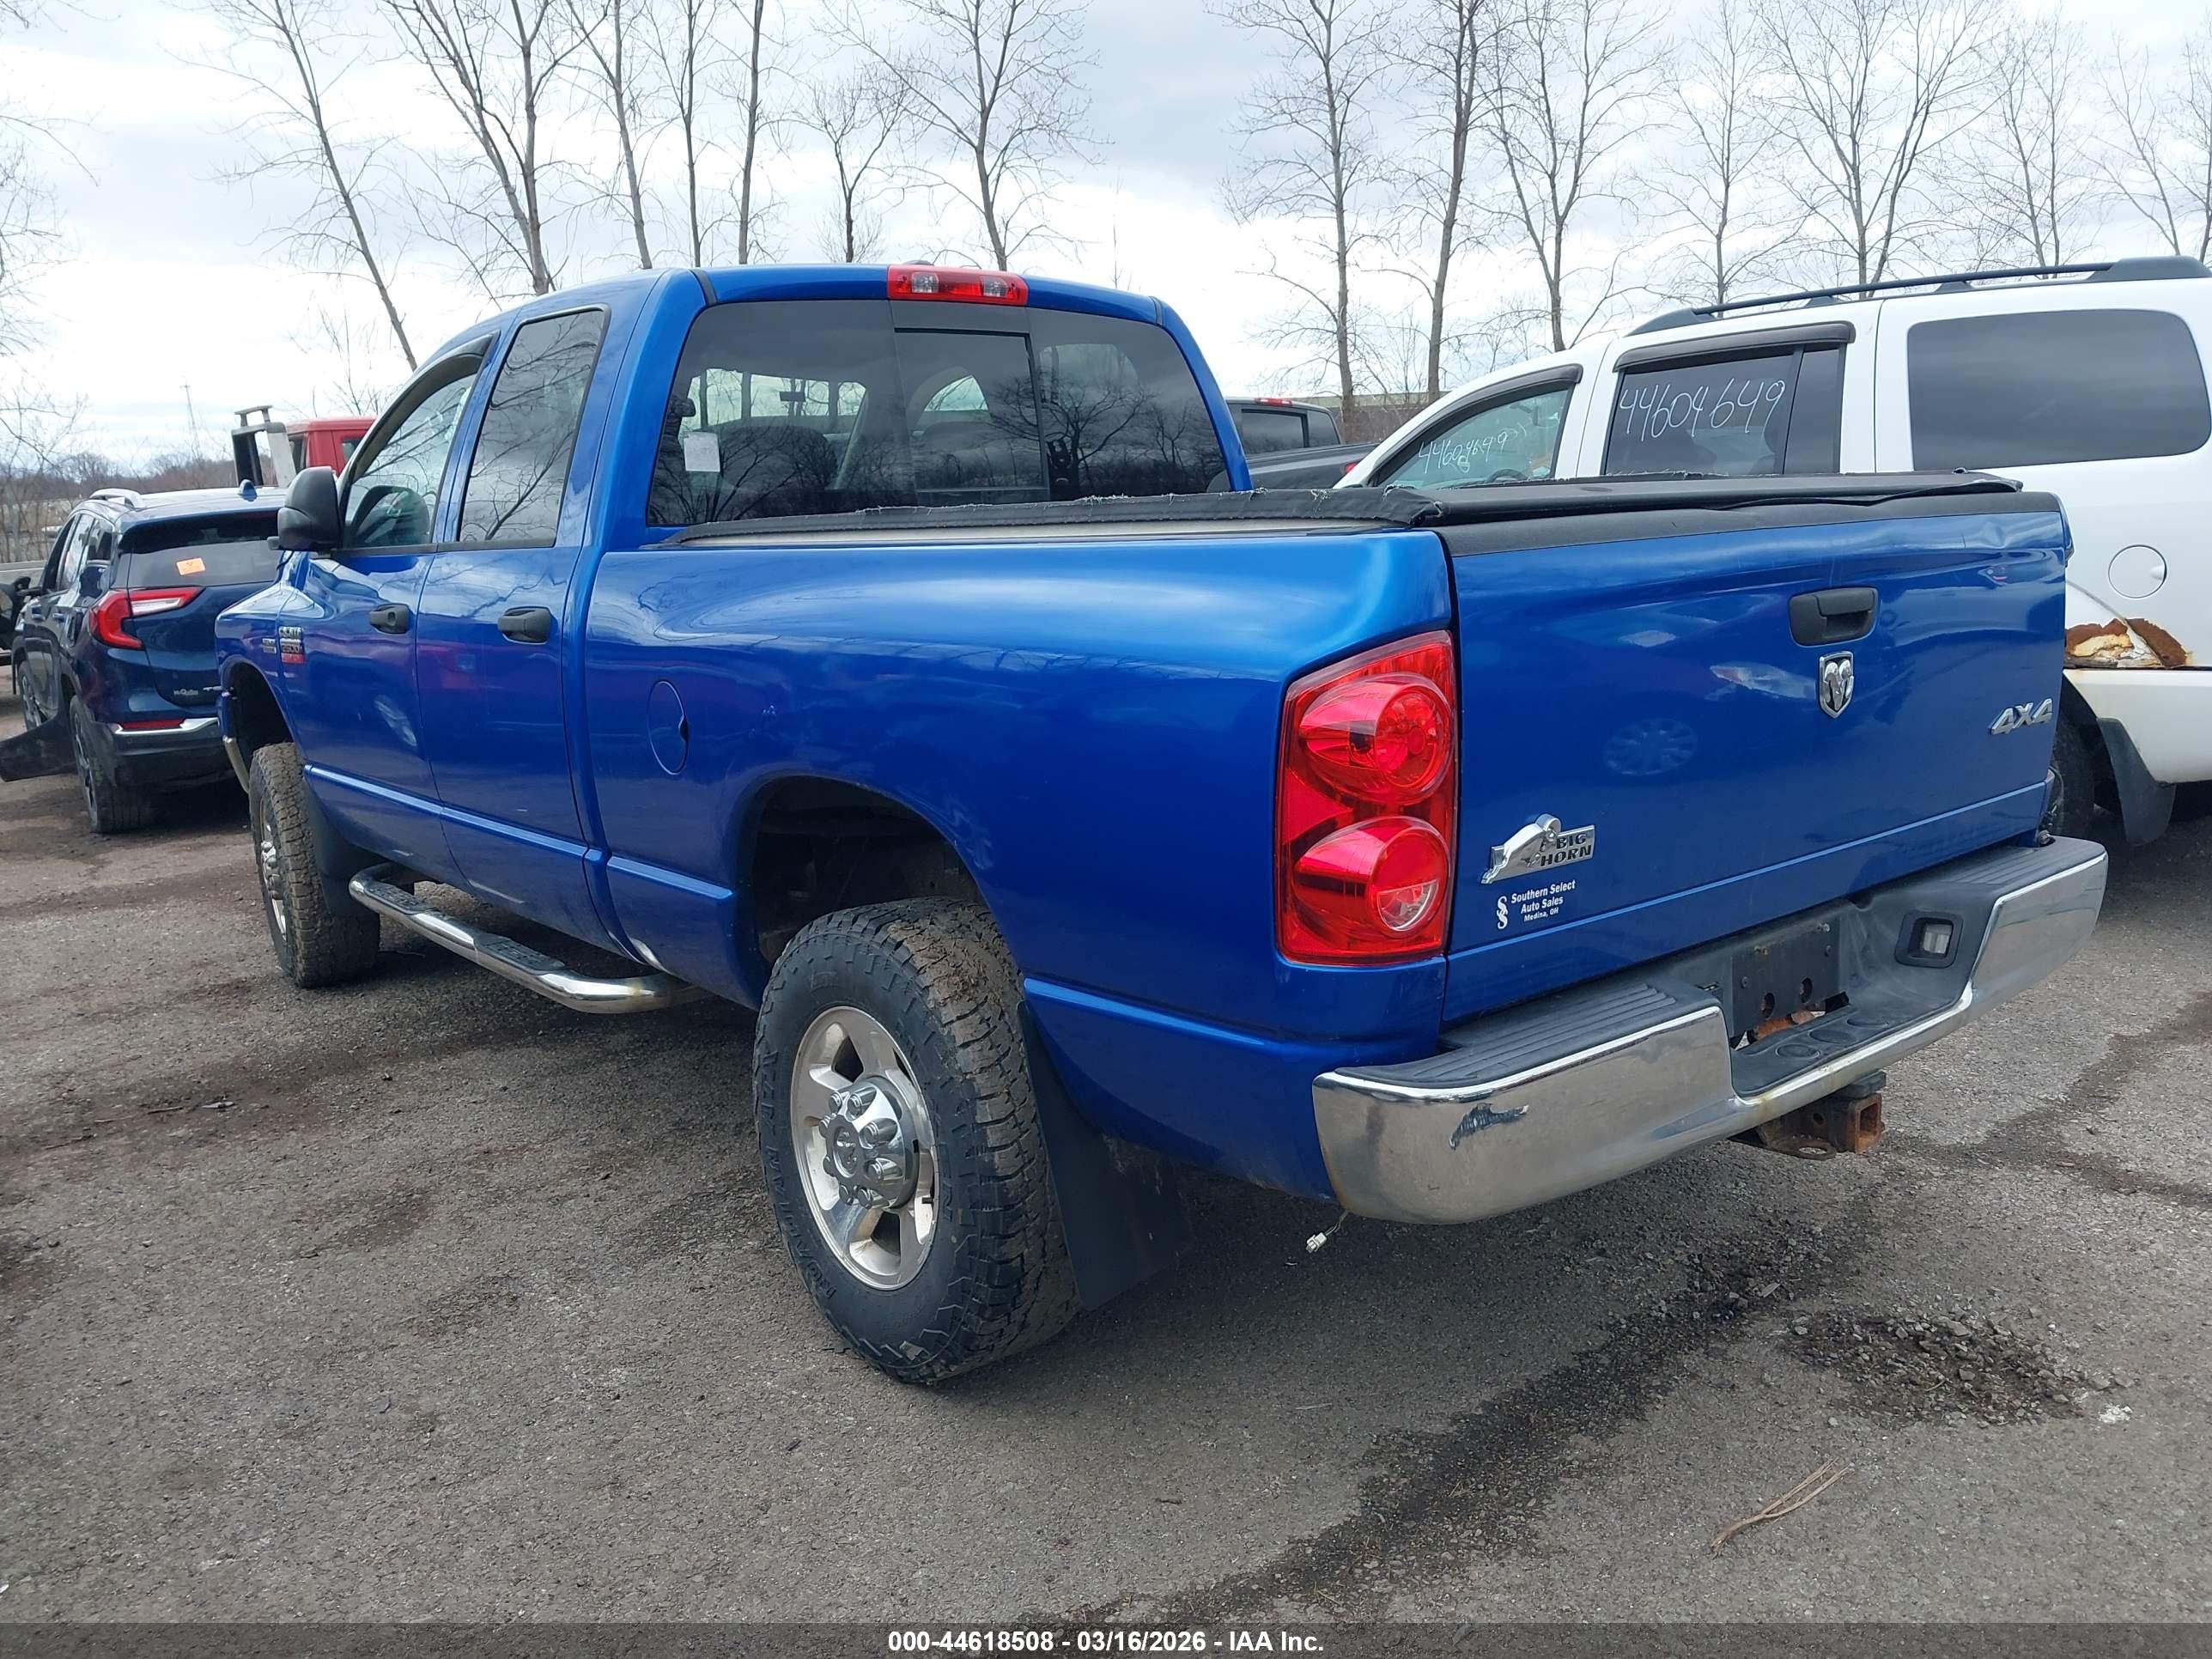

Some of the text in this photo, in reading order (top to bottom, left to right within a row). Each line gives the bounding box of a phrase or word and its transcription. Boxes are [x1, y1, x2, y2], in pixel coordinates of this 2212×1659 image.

[1620, 378, 1786, 441] 44604649
[1556, 832, 1587, 848] BIG
[1540, 844, 1592, 866] HORN
[1510, 879, 1576, 903] Southern Select
[1520, 896, 1564, 915] Auto Sales
[1523, 907, 1559, 921] Medina, OH
